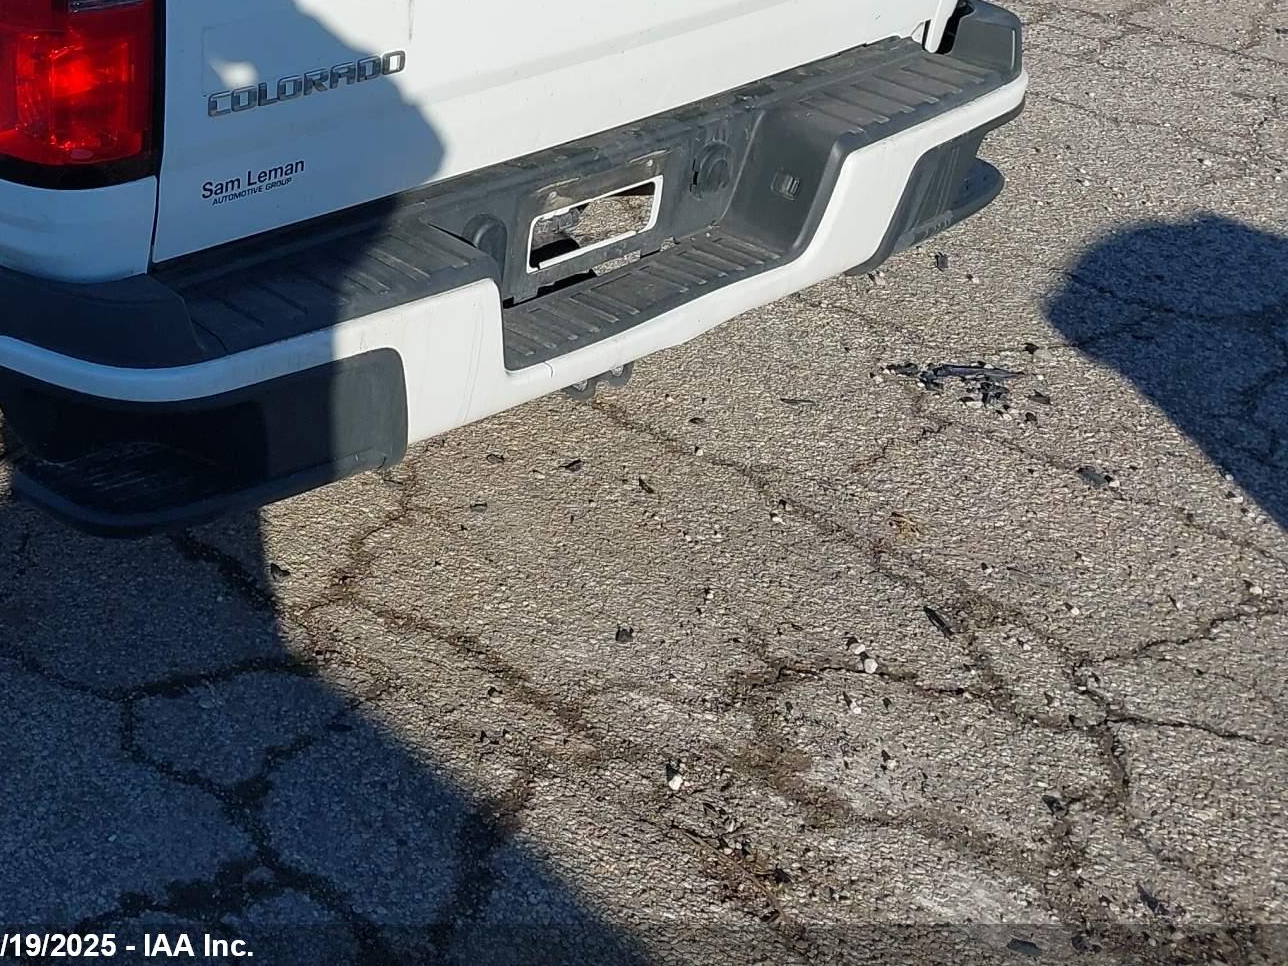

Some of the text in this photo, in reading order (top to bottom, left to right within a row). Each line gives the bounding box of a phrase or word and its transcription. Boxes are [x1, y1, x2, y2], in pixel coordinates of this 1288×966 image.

[207, 50, 406, 118] COLORADO
[201, 160, 305, 199] Sam Leman
[212, 176, 292, 206] AUTOMOTIVE GROUP
